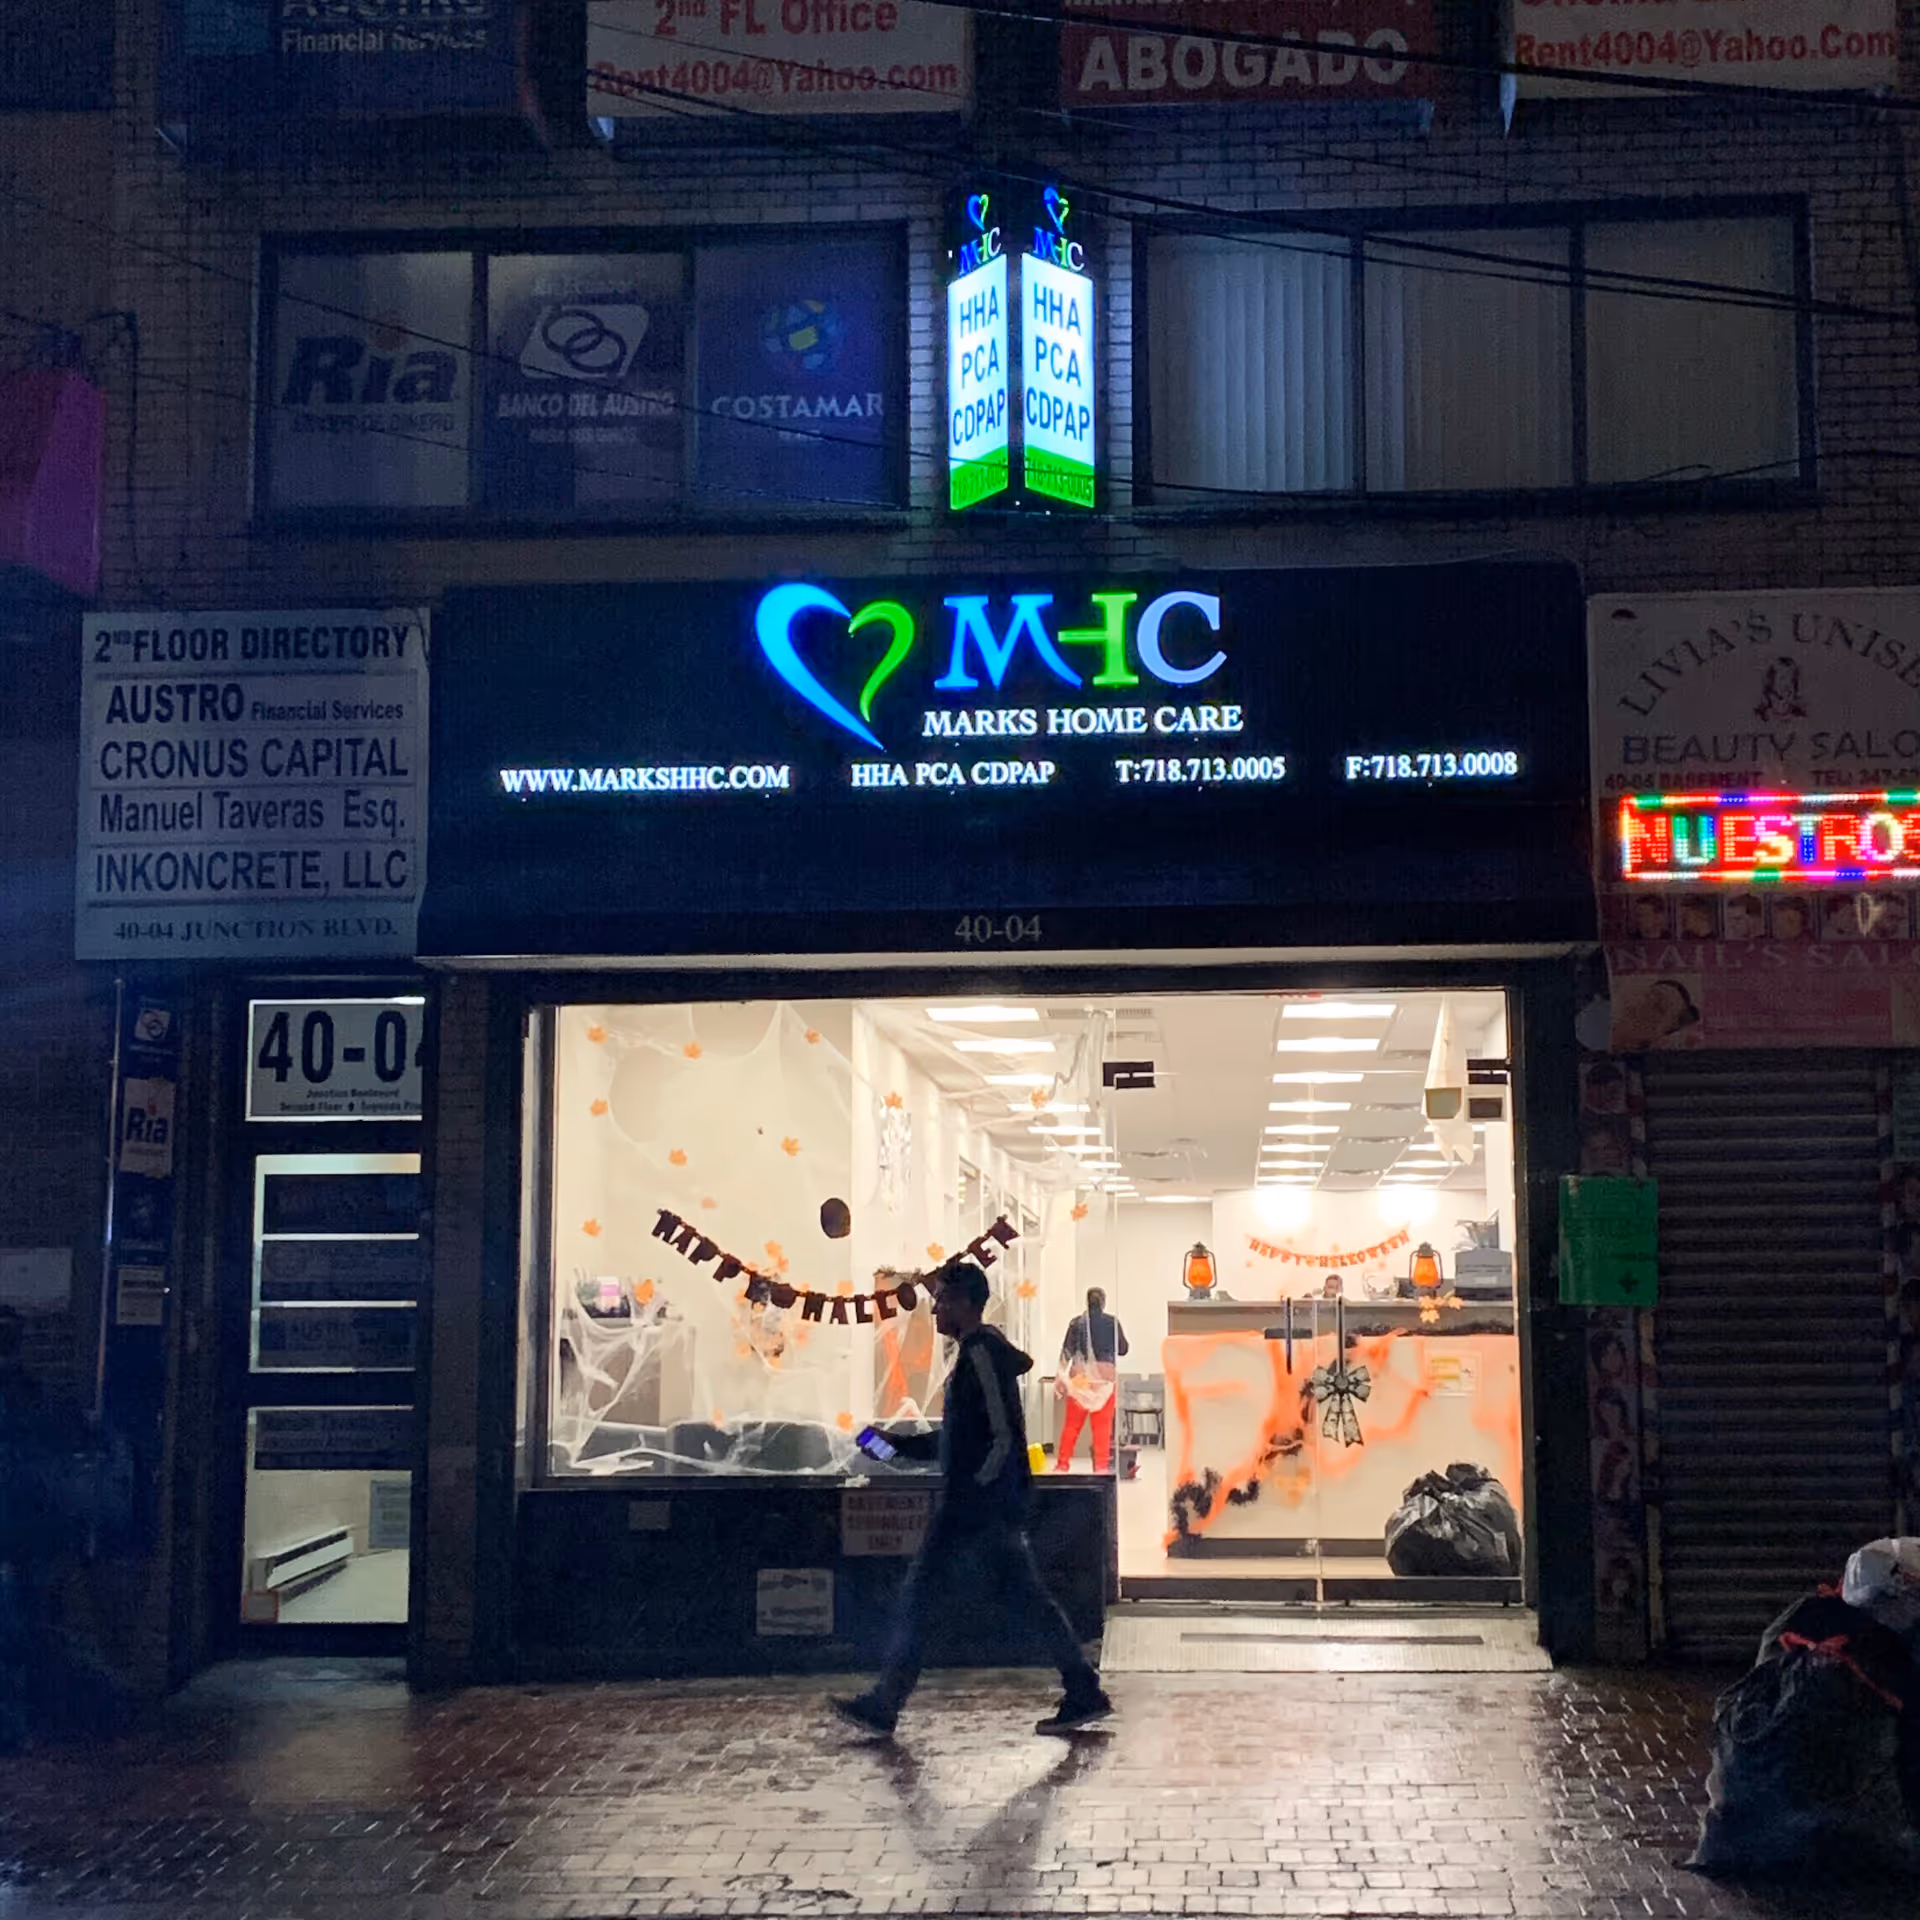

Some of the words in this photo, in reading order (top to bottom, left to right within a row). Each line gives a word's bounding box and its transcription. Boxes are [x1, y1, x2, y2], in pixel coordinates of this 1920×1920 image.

[720, 0, 767, 35] FL
[781, 0, 898, 34] Office
[1078, 27, 1409, 92] ABOGADO
[958, 227, 1001, 278] MHC
[1033, 225, 1084, 272] MHC
[960, 285, 999, 338] HHA
[1034, 281, 1081, 336] HHA
[962, 337, 999, 389] PCA
[1036, 335, 1081, 387] PCA
[498, 392, 563, 417] BANCO
[711, 392, 884, 418] COSTAMAR
[953, 388, 1005, 446] CDPAP
[1026, 386, 1090, 442] CDPAP
[241, 626, 410, 659] DIRECTORY
[934, 590, 1227, 688] MHC
[1618, 611, 1772, 717] LIVIA'S
[106, 684, 244, 723] AUSTRO
[252, 701, 327, 721] Financial
[332, 700, 405, 720] Services
[922, 709, 1037, 737] MARKS
[1046, 707, 1148, 735] HOME
[1155, 705, 1244, 733] CARE
[101, 739, 249, 780] CRONUS
[260, 738, 409, 777] CAPITAL
[1346, 751, 1519, 779] F:718.713.0008
[1622, 732, 1797, 765] BEAUTY
[500, 764, 791, 793] WWW.MARKSHHC.COM
[851, 763, 909, 787] HHA
[914, 762, 966, 786] PCA
[971, 760, 1056, 785] CDPAP
[1115, 756, 1287, 784] T:718.713.0005
[101, 792, 202, 832] Manuel
[213, 791, 324, 829] Taveras
[343, 790, 406, 837] Esq.
[96, 851, 330, 897] INKONCRETE,
[343, 850, 408, 888] LLC
[113, 921, 174, 940] 40-04
[181, 919, 314, 940] JUNCTION
[323, 917, 398, 936] BLVD.
[954, 914, 1043, 943] 40-04
[126, 1108, 169, 1144] Ria
